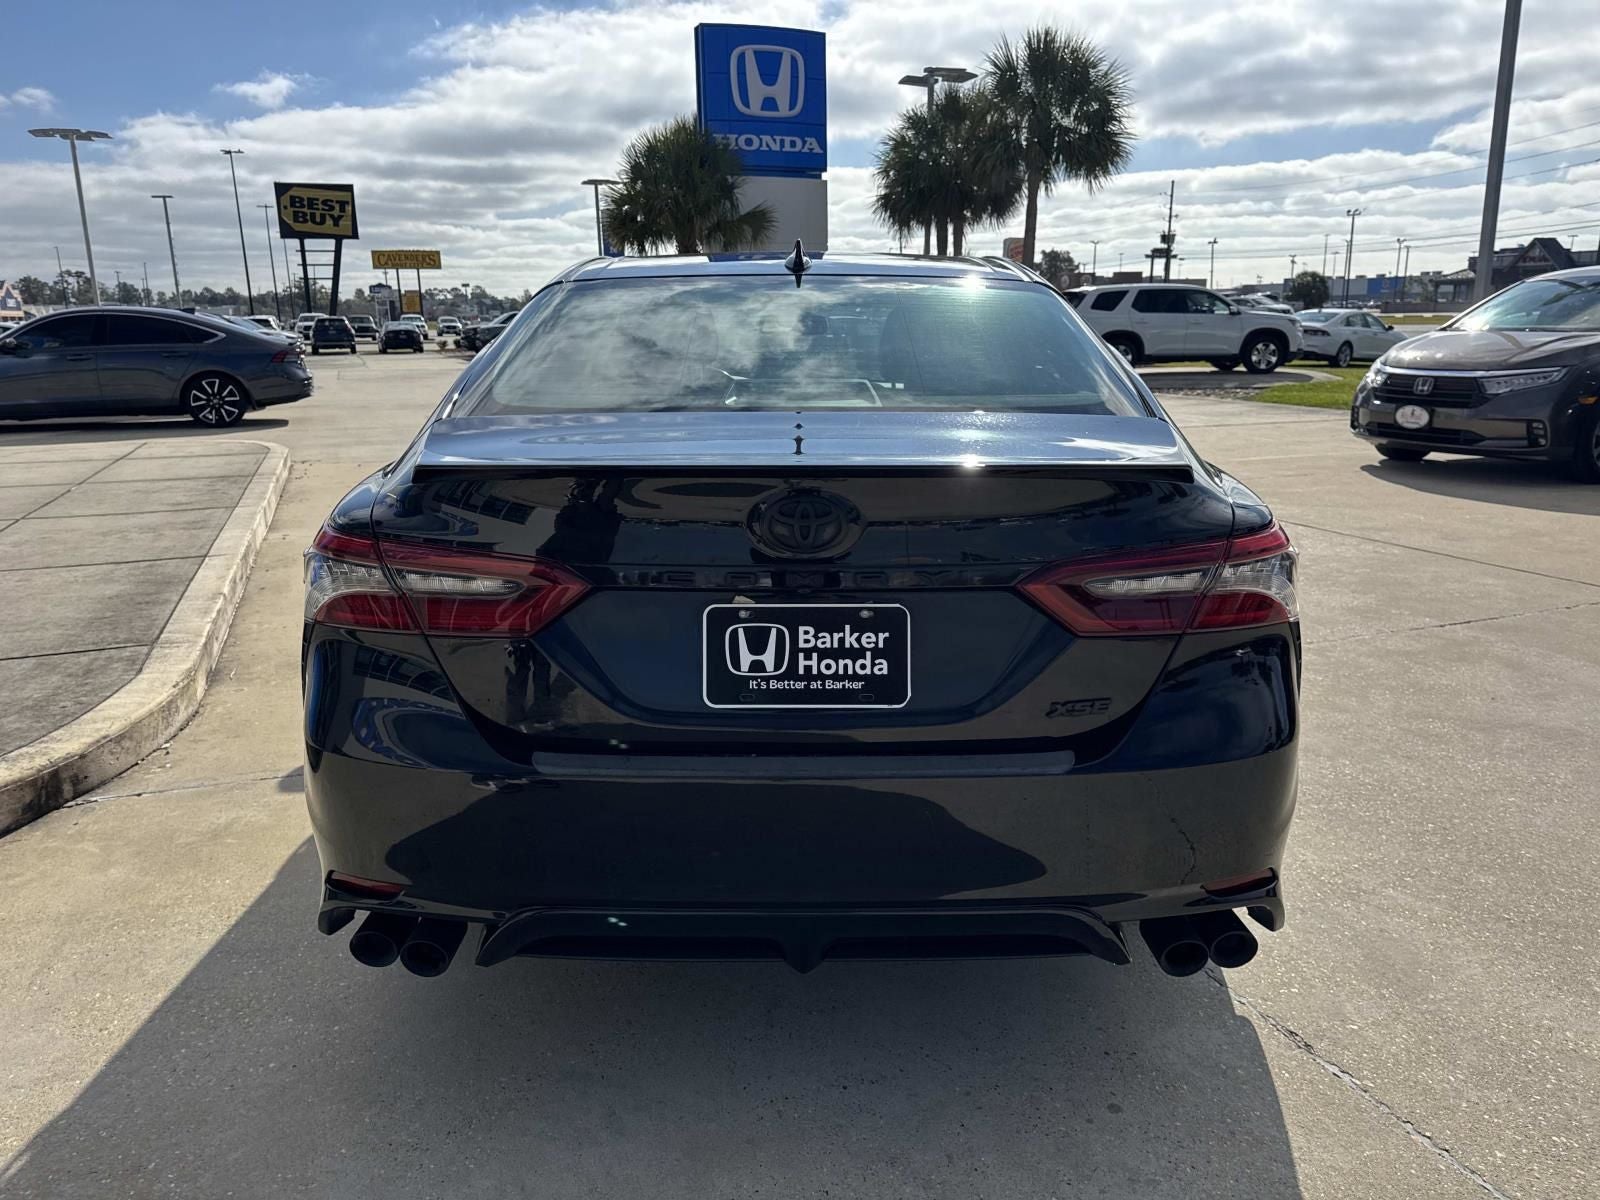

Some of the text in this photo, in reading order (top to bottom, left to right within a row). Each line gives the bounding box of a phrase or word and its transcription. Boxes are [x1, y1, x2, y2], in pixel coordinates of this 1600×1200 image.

[712, 133, 824, 154] HONDA
[289, 195, 350, 214] BEST
[292, 210, 345, 228] BUY
[798, 624, 890, 649] Barker
[798, 651, 889, 675] Honda
[749, 678, 865, 689] It's Better at Barker
[1045, 697, 1112, 718] XSE
